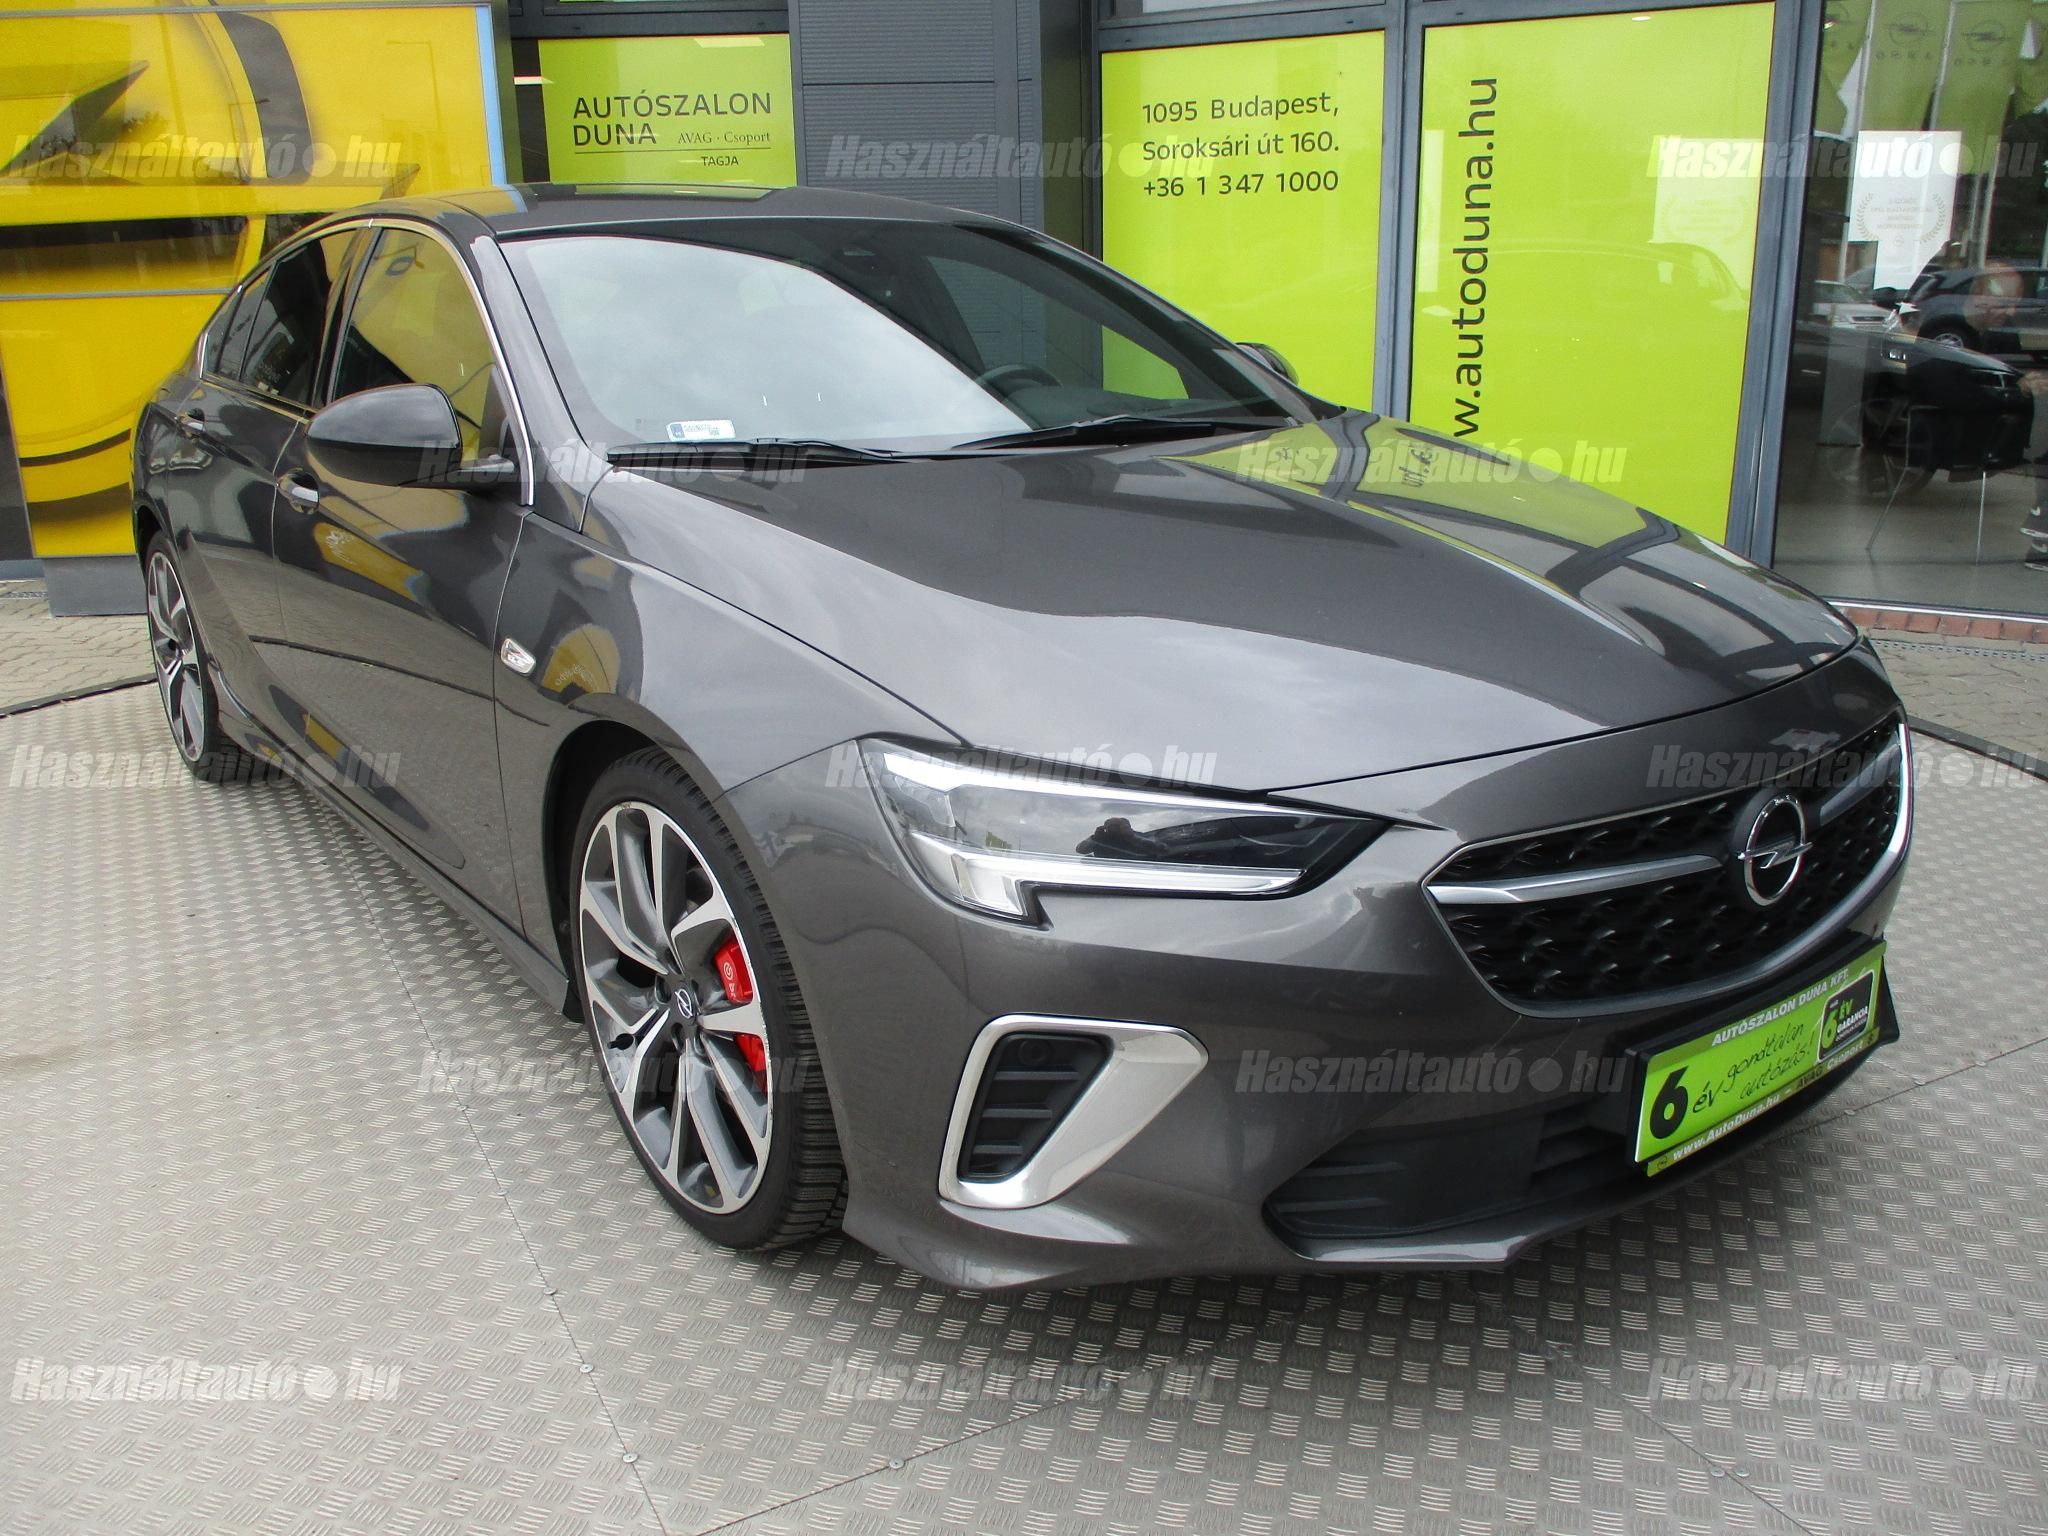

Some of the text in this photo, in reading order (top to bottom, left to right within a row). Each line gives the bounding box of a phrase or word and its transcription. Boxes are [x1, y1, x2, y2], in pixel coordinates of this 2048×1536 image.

[573, 89, 771, 119] AUTÓSZALON
[1142, 92, 1339, 124] 1095 Budapest,
[573, 123, 771, 147] DUNA AVAG Csoport
[1142, 131, 1340, 161] Soroksári út 160.
[701, 156, 739, 167] TAGJA
[1143, 170, 1339, 197] +36 1 347 1000
[1712, 1000, 1796, 1047] AUTÓSZALON
[1798, 980, 1829, 1008] DUNA
[1822, 1008, 1839, 1049] 6
[1650, 1066, 1689, 1140] 6
[1692, 1080, 1724, 1114] év
